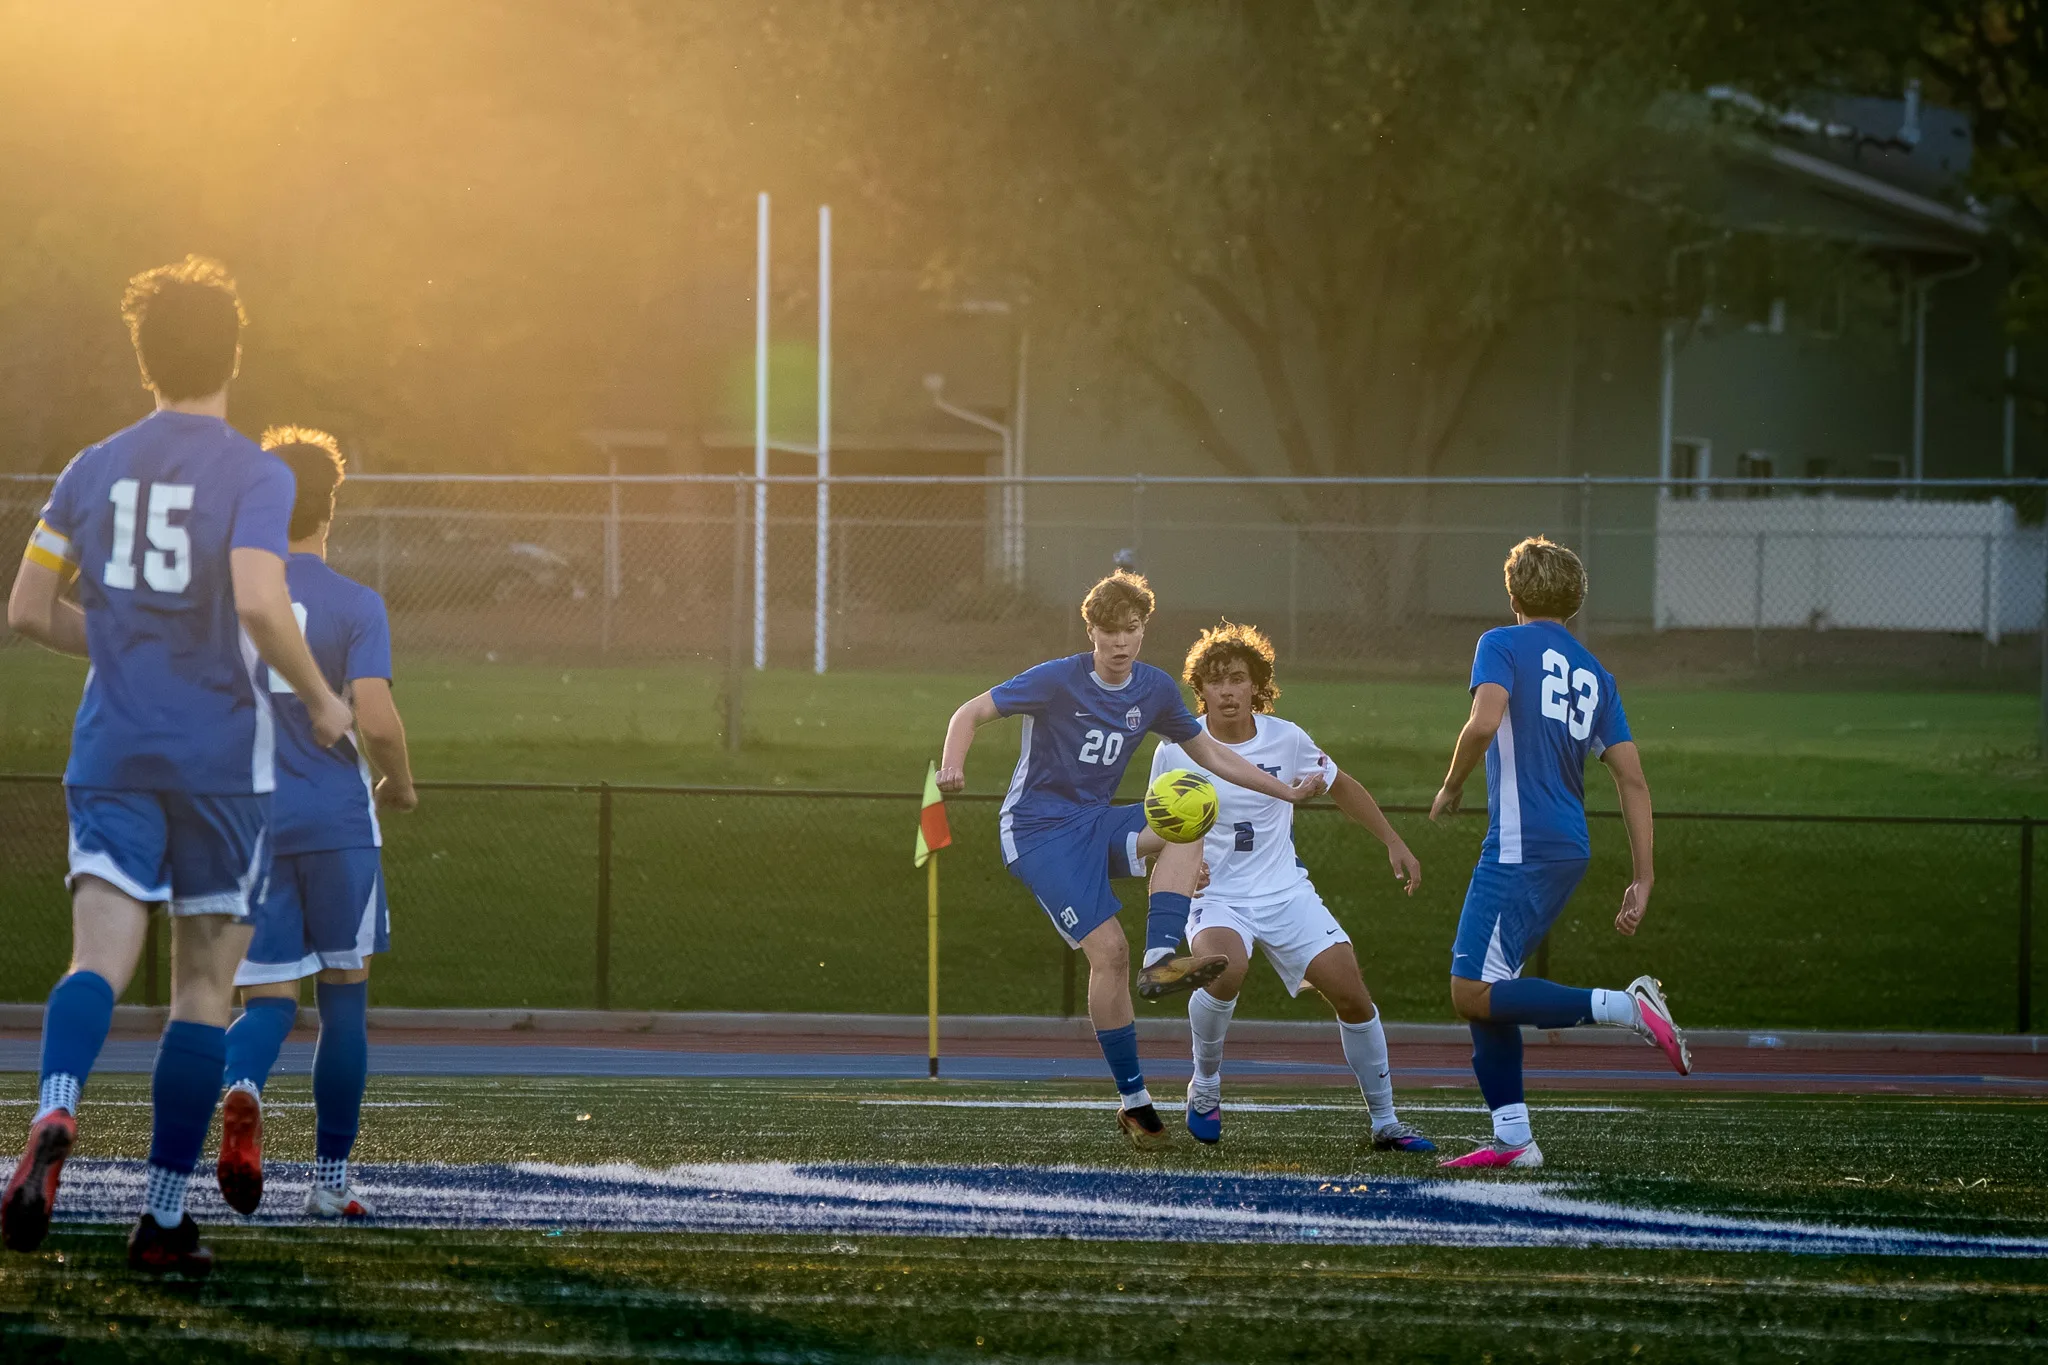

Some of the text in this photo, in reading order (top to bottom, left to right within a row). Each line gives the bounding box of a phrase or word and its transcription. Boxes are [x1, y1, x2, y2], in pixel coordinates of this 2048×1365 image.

[103, 478, 195, 593] 15
[1541, 648, 1599, 740] 23
[1079, 729, 1124, 765] 20
[1233, 821, 1254, 851] 2
[1060, 906, 1079, 928] 20
